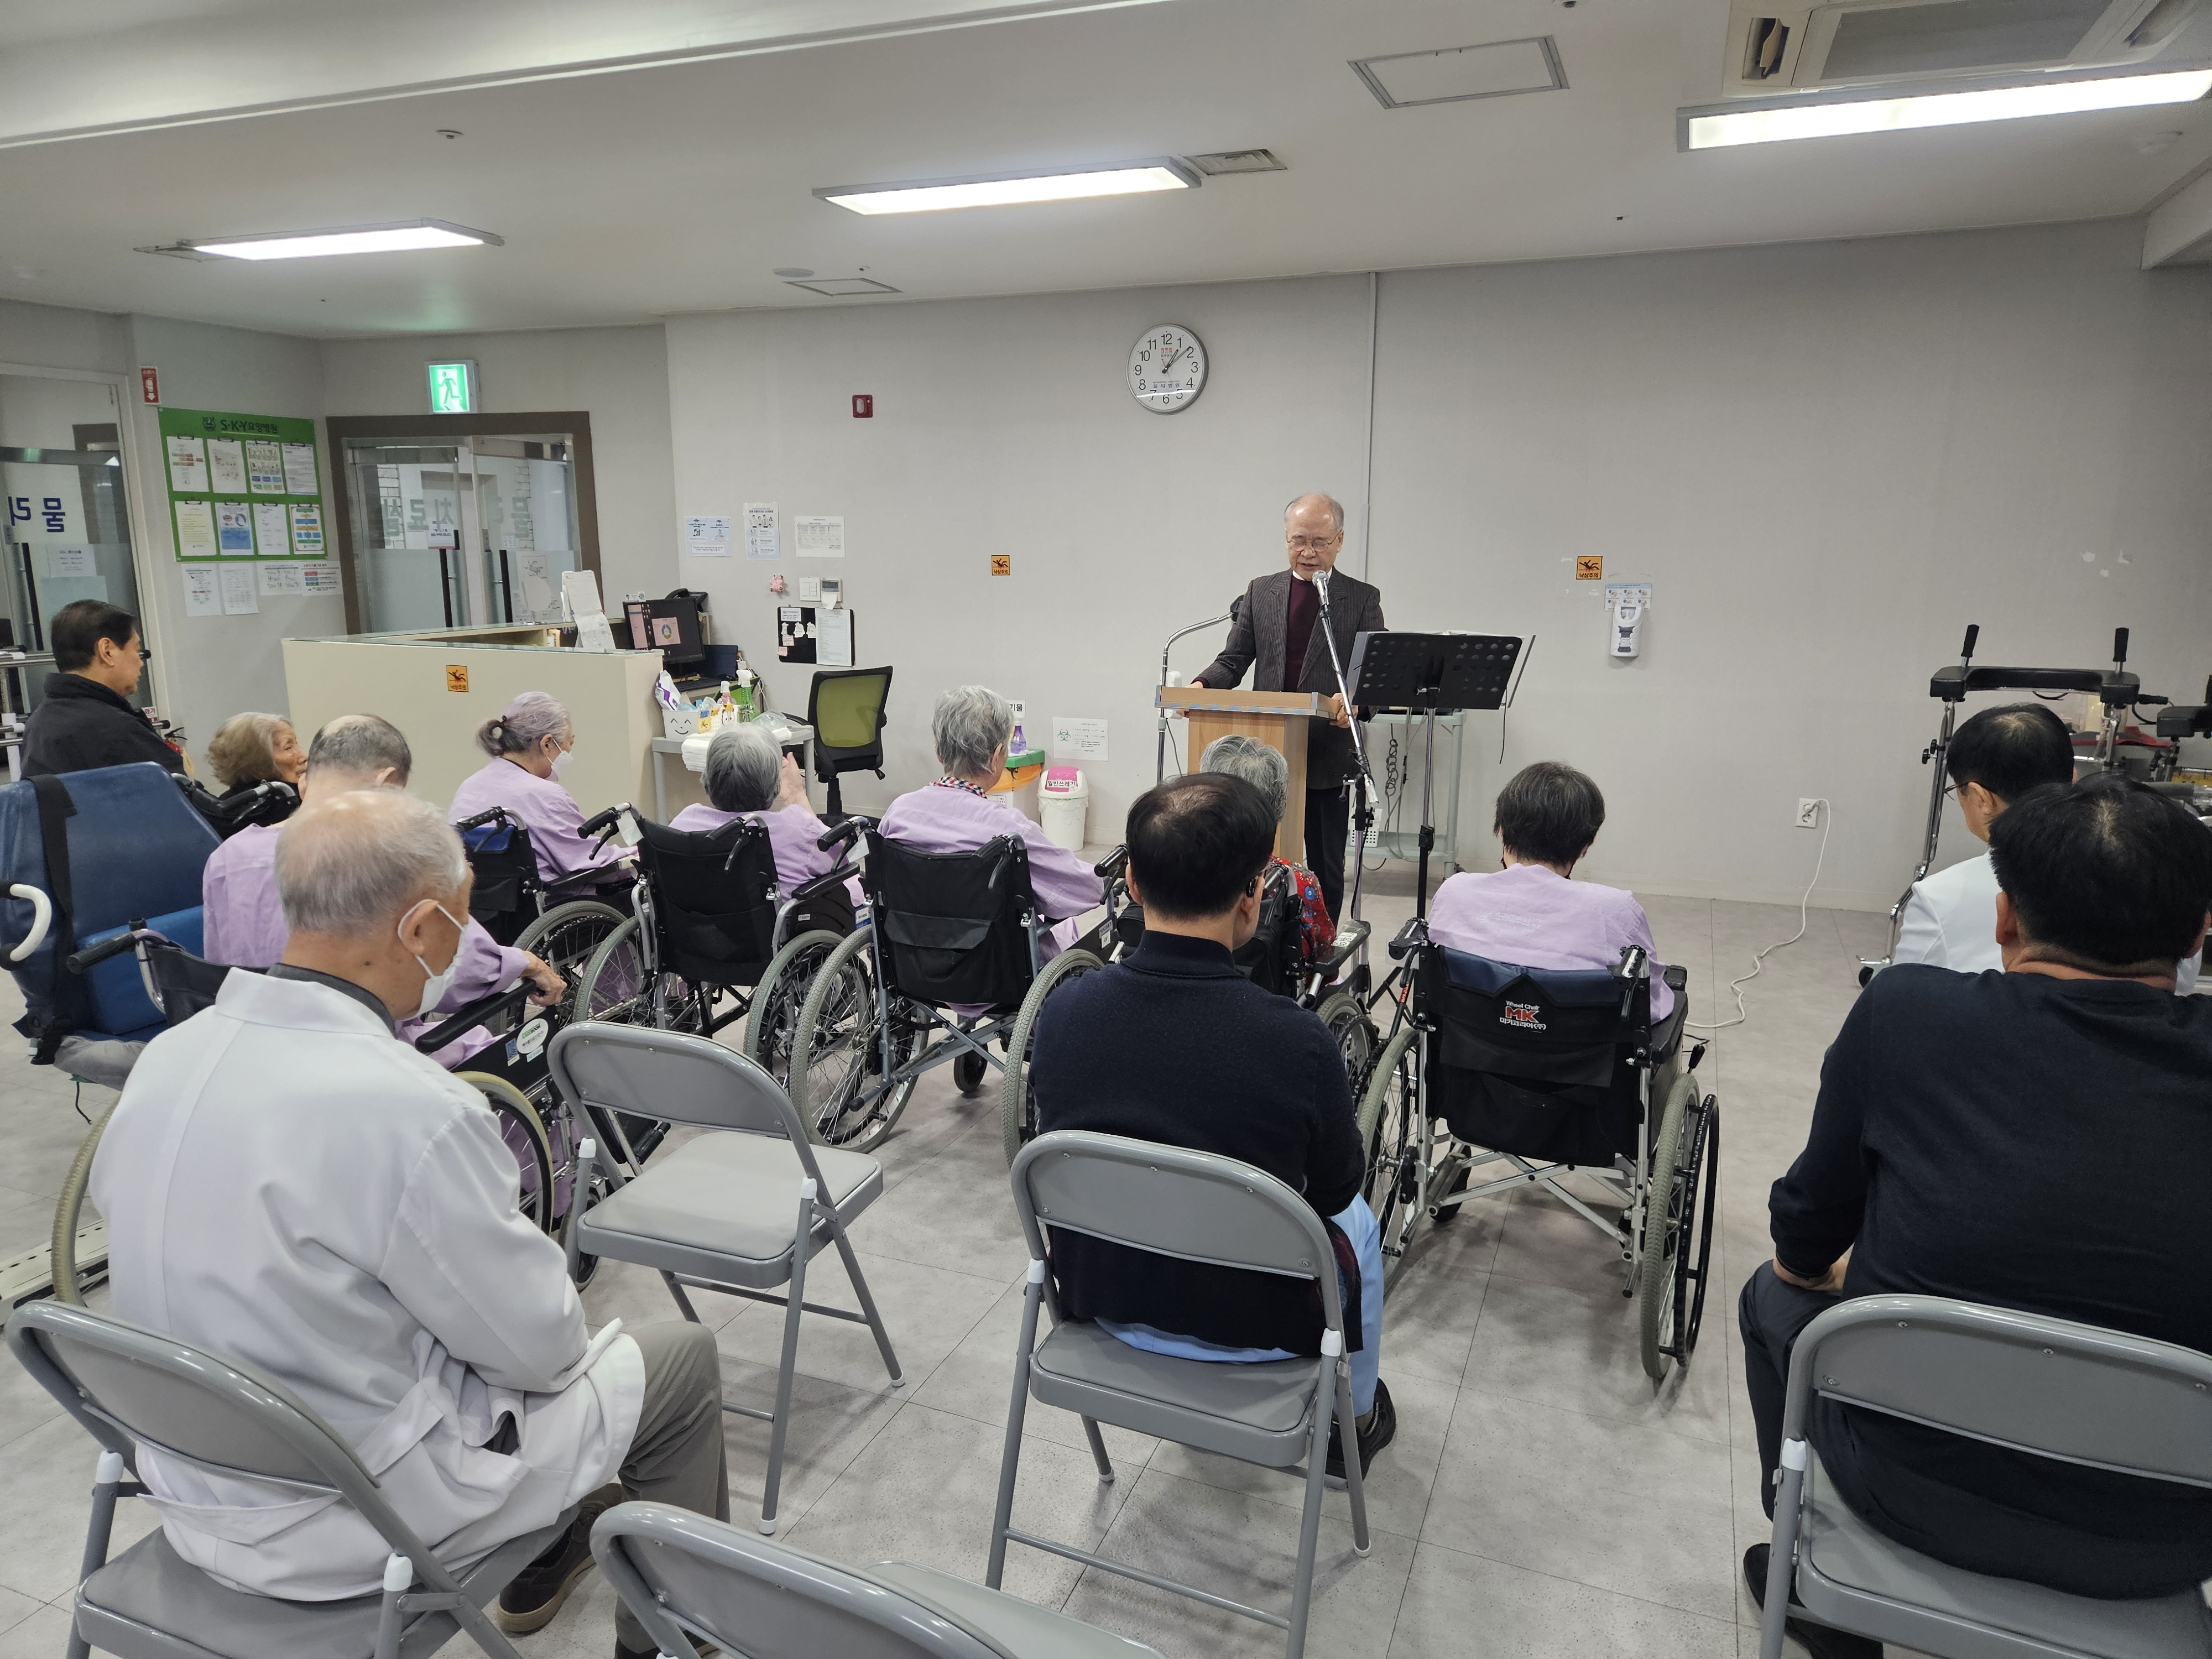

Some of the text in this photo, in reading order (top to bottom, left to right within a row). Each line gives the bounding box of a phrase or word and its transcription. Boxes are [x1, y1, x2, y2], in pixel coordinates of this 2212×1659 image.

[1147, 338, 1157, 350] 11
[1161, 333, 1172, 345] 12
[1177, 337, 1182, 348] 1
[1139, 350, 1150, 362] 10
[1187, 347, 1194, 358] 2
[1135, 364, 1142, 375] 9
[1191, 362, 1198, 373] 3
[1139, 379, 1146, 390] 8
[1186, 377, 1193, 388] 4
[1150, 390, 1157, 401] 7
[1163, 393, 1170, 404] 6
[1176, 389, 1183, 400] 5
[1008, 703, 1023, 712] 기물
[1505, 1000, 1524, 1008] Wheel
[1505, 1006, 1540, 1023] MK
[1499, 1016, 1547, 1030] 미키코리아(주)
